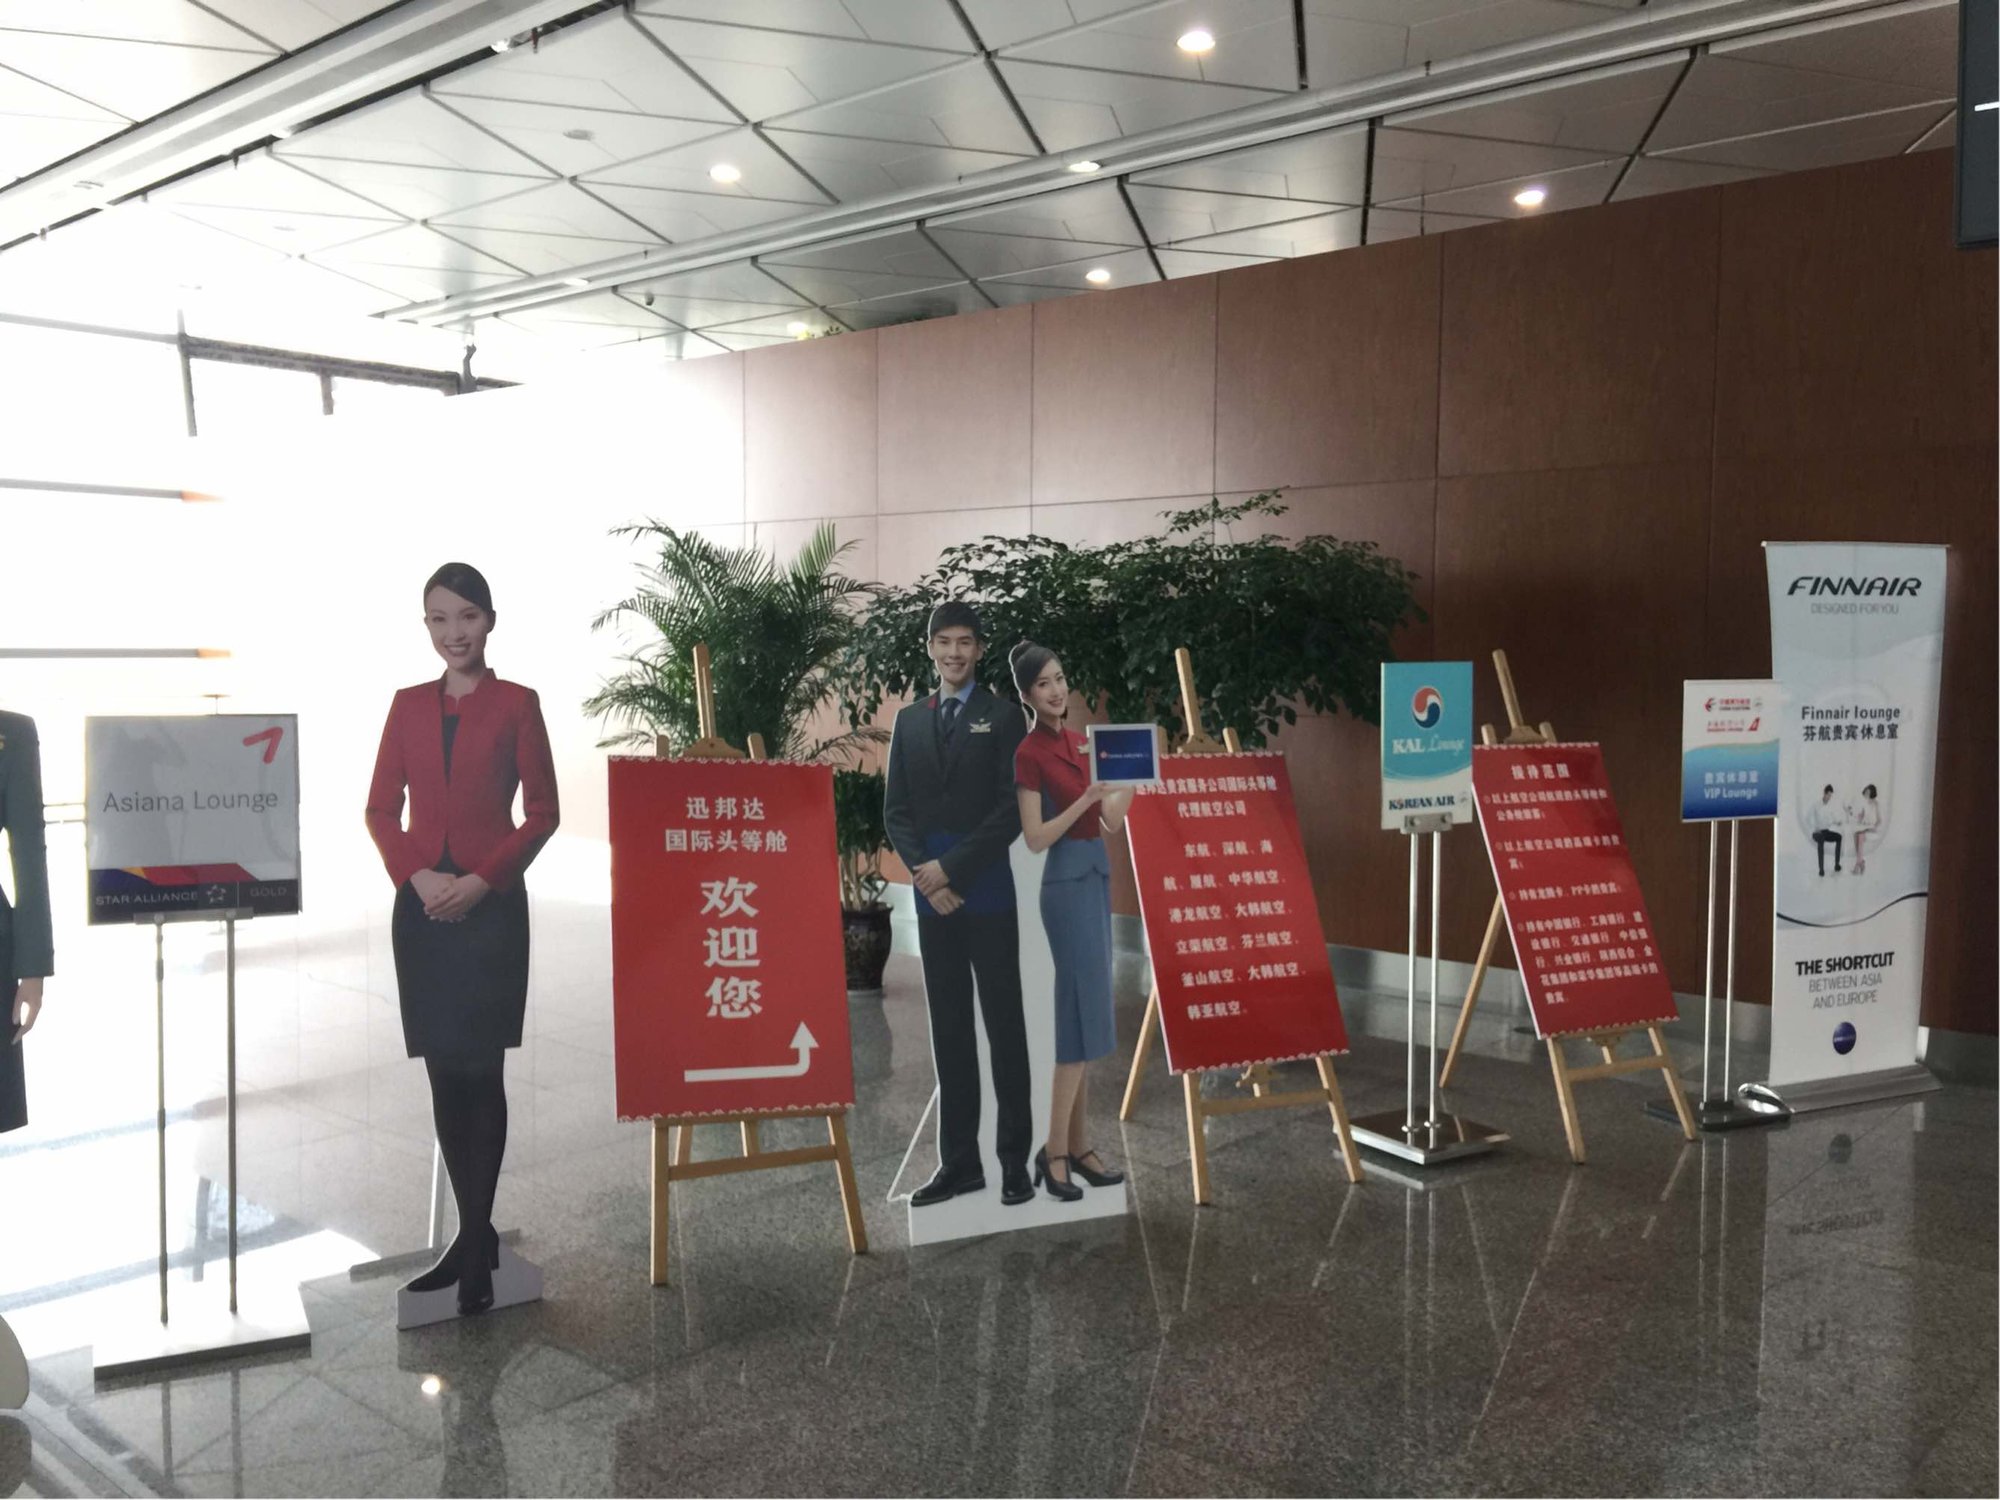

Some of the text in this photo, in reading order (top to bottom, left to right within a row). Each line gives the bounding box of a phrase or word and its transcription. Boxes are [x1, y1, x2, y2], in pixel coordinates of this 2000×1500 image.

[1787, 576, 1922, 597] FINNAIR
[1811, 602, 1899, 615] DESIGNED FOR YOU
[1802, 705, 1901, 722] Finnair lounge
[1803, 723, 1899, 741] 芬航贵宾休息室
[1392, 738, 1425, 755] KAL
[103, 790, 278, 813] Asiana Lounge
[1388, 796, 1455, 810] KOREAN AIR
[1704, 787, 1758, 800] VIP Lounge
[686, 797, 765, 820] 迅邦达
[665, 828, 787, 853] 国际头等舱
[96, 886, 287, 906] STAR ALLIANCE GOLD
[700, 876, 762, 1019] 欢迎您
[1795, 951, 1895, 976] THE SHORTCUT
[1809, 972, 1882, 993] BETWEEN ASIA
[1813, 989, 1878, 1010] AND EUROPE
